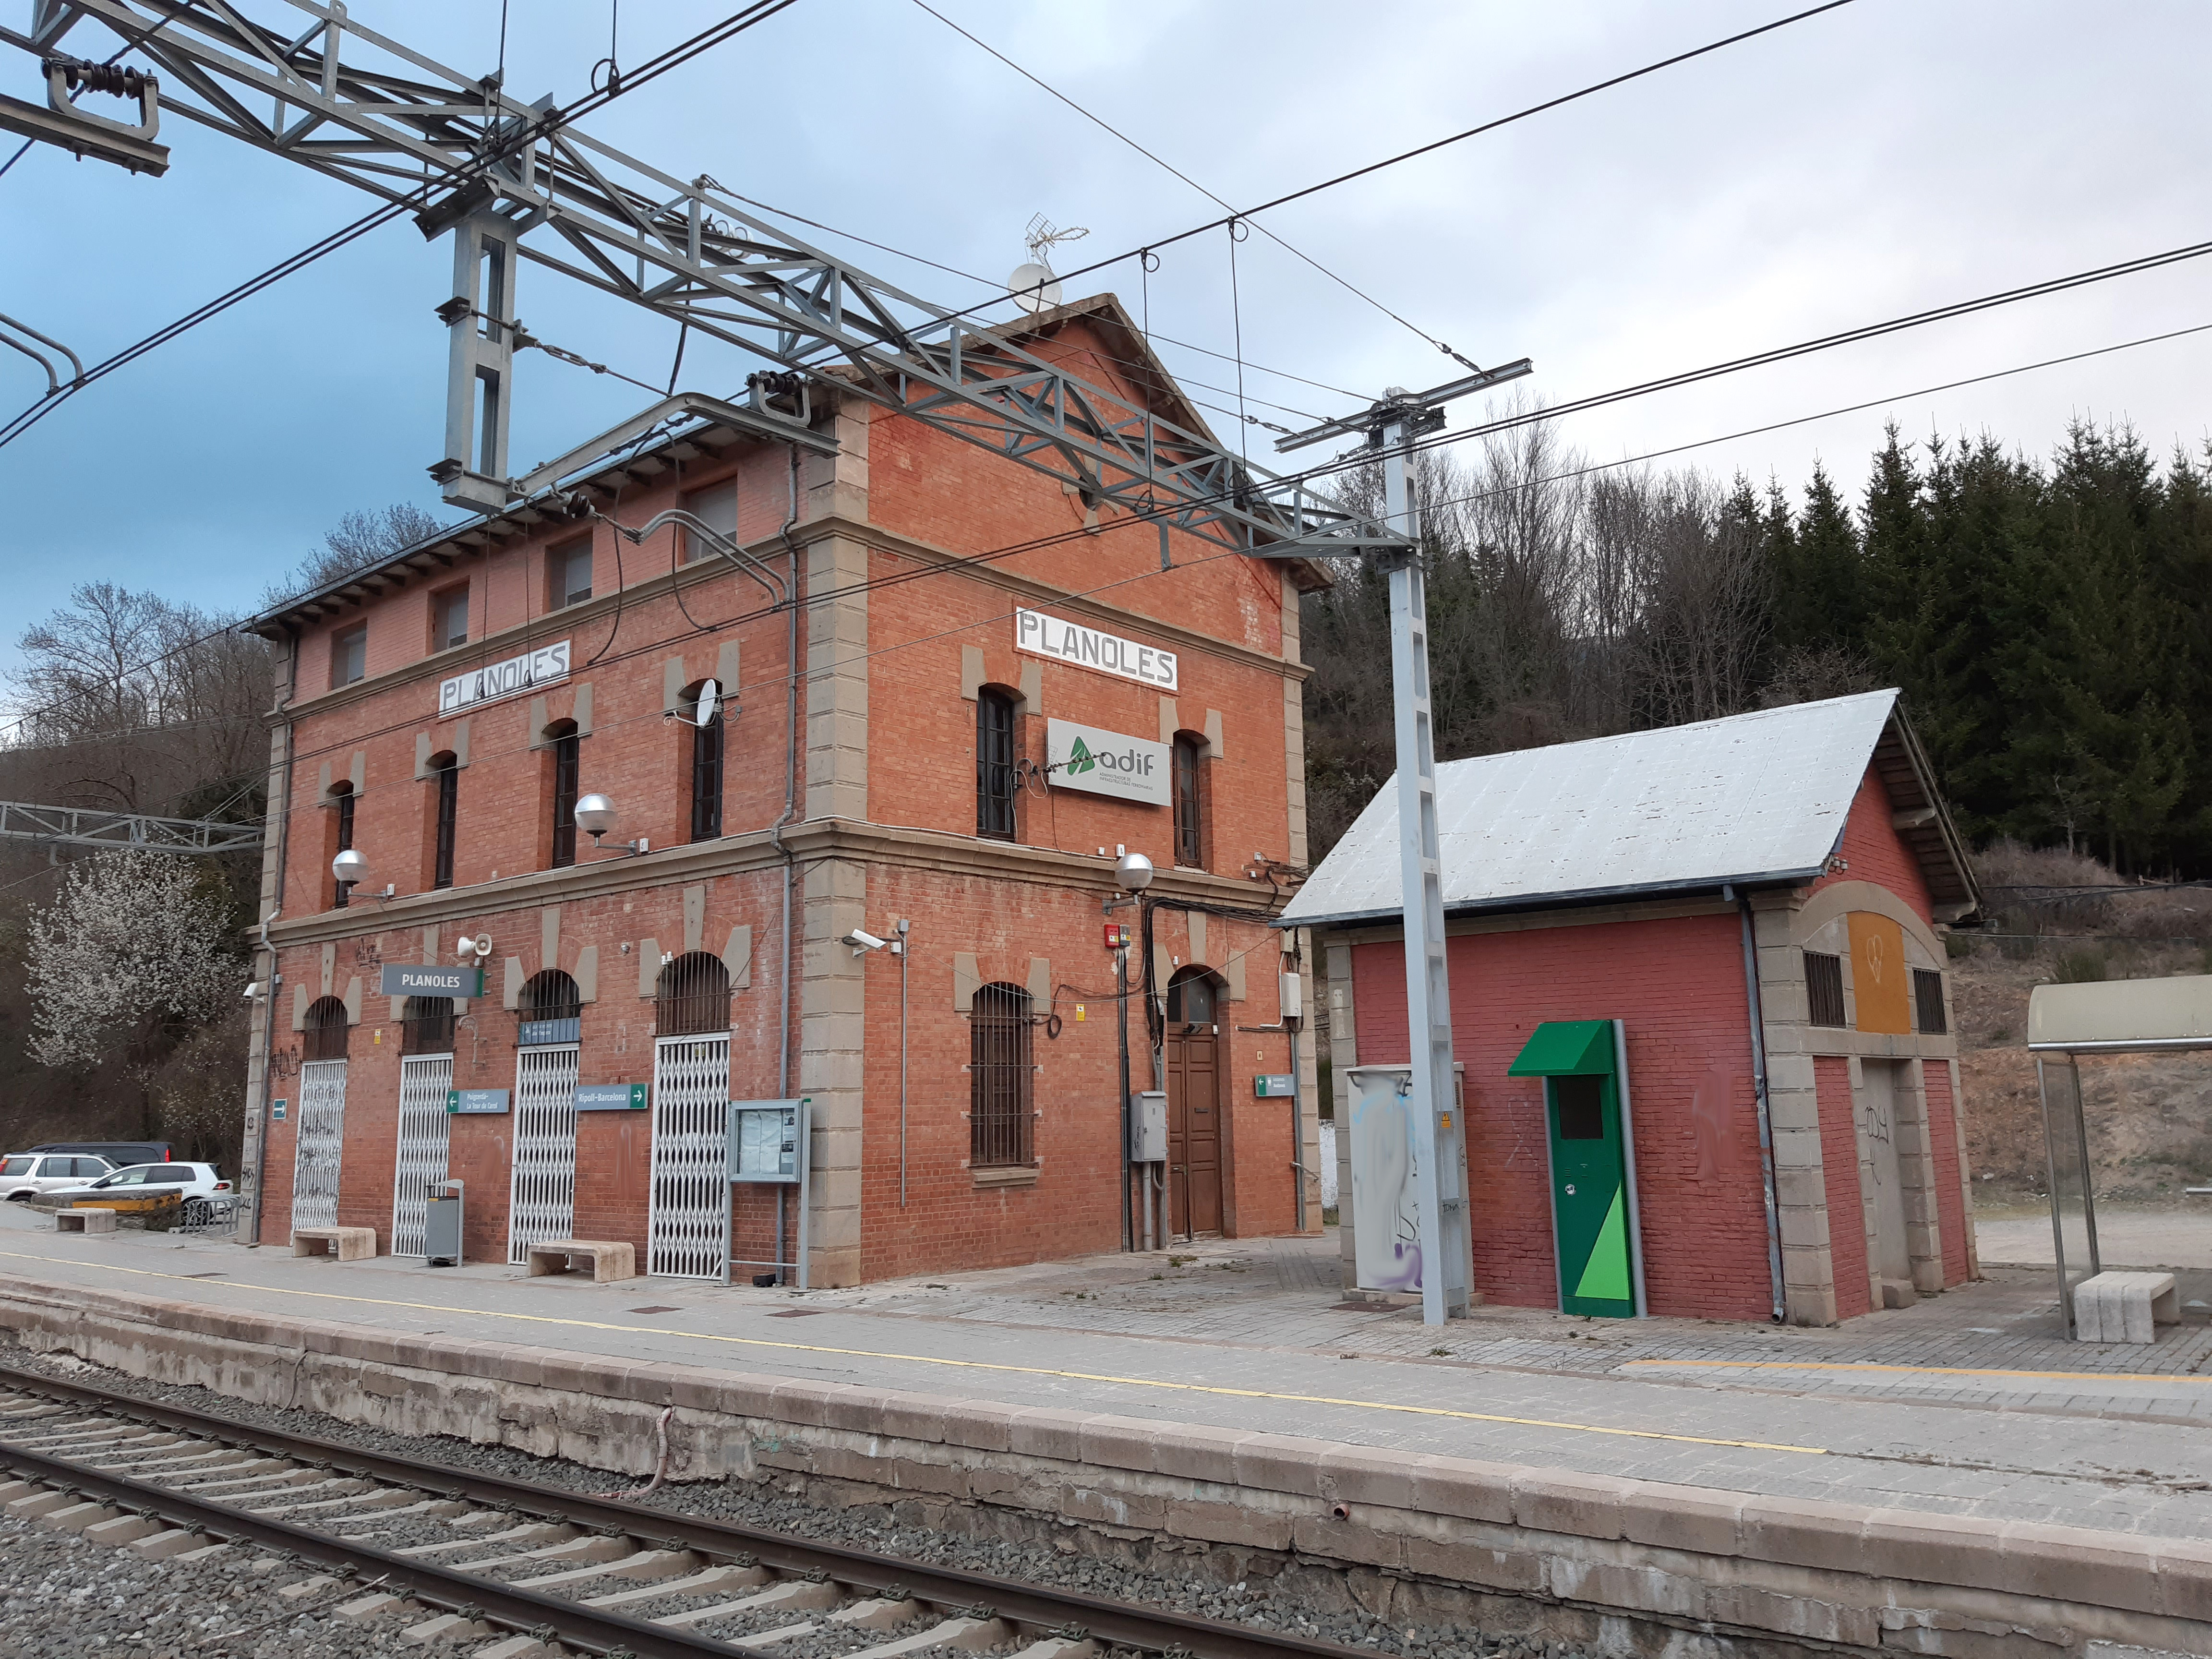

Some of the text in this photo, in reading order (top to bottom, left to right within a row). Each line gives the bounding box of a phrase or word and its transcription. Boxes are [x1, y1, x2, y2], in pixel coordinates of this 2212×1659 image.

[1020, 613, 1174, 684] PLANOLES
[443, 645, 566, 710] PLANOLES
[1099, 749, 1154, 776] adif
[402, 974, 460, 988] PLANOLES
[578, 1092, 626, 1104] Ripoll-Barcelona
